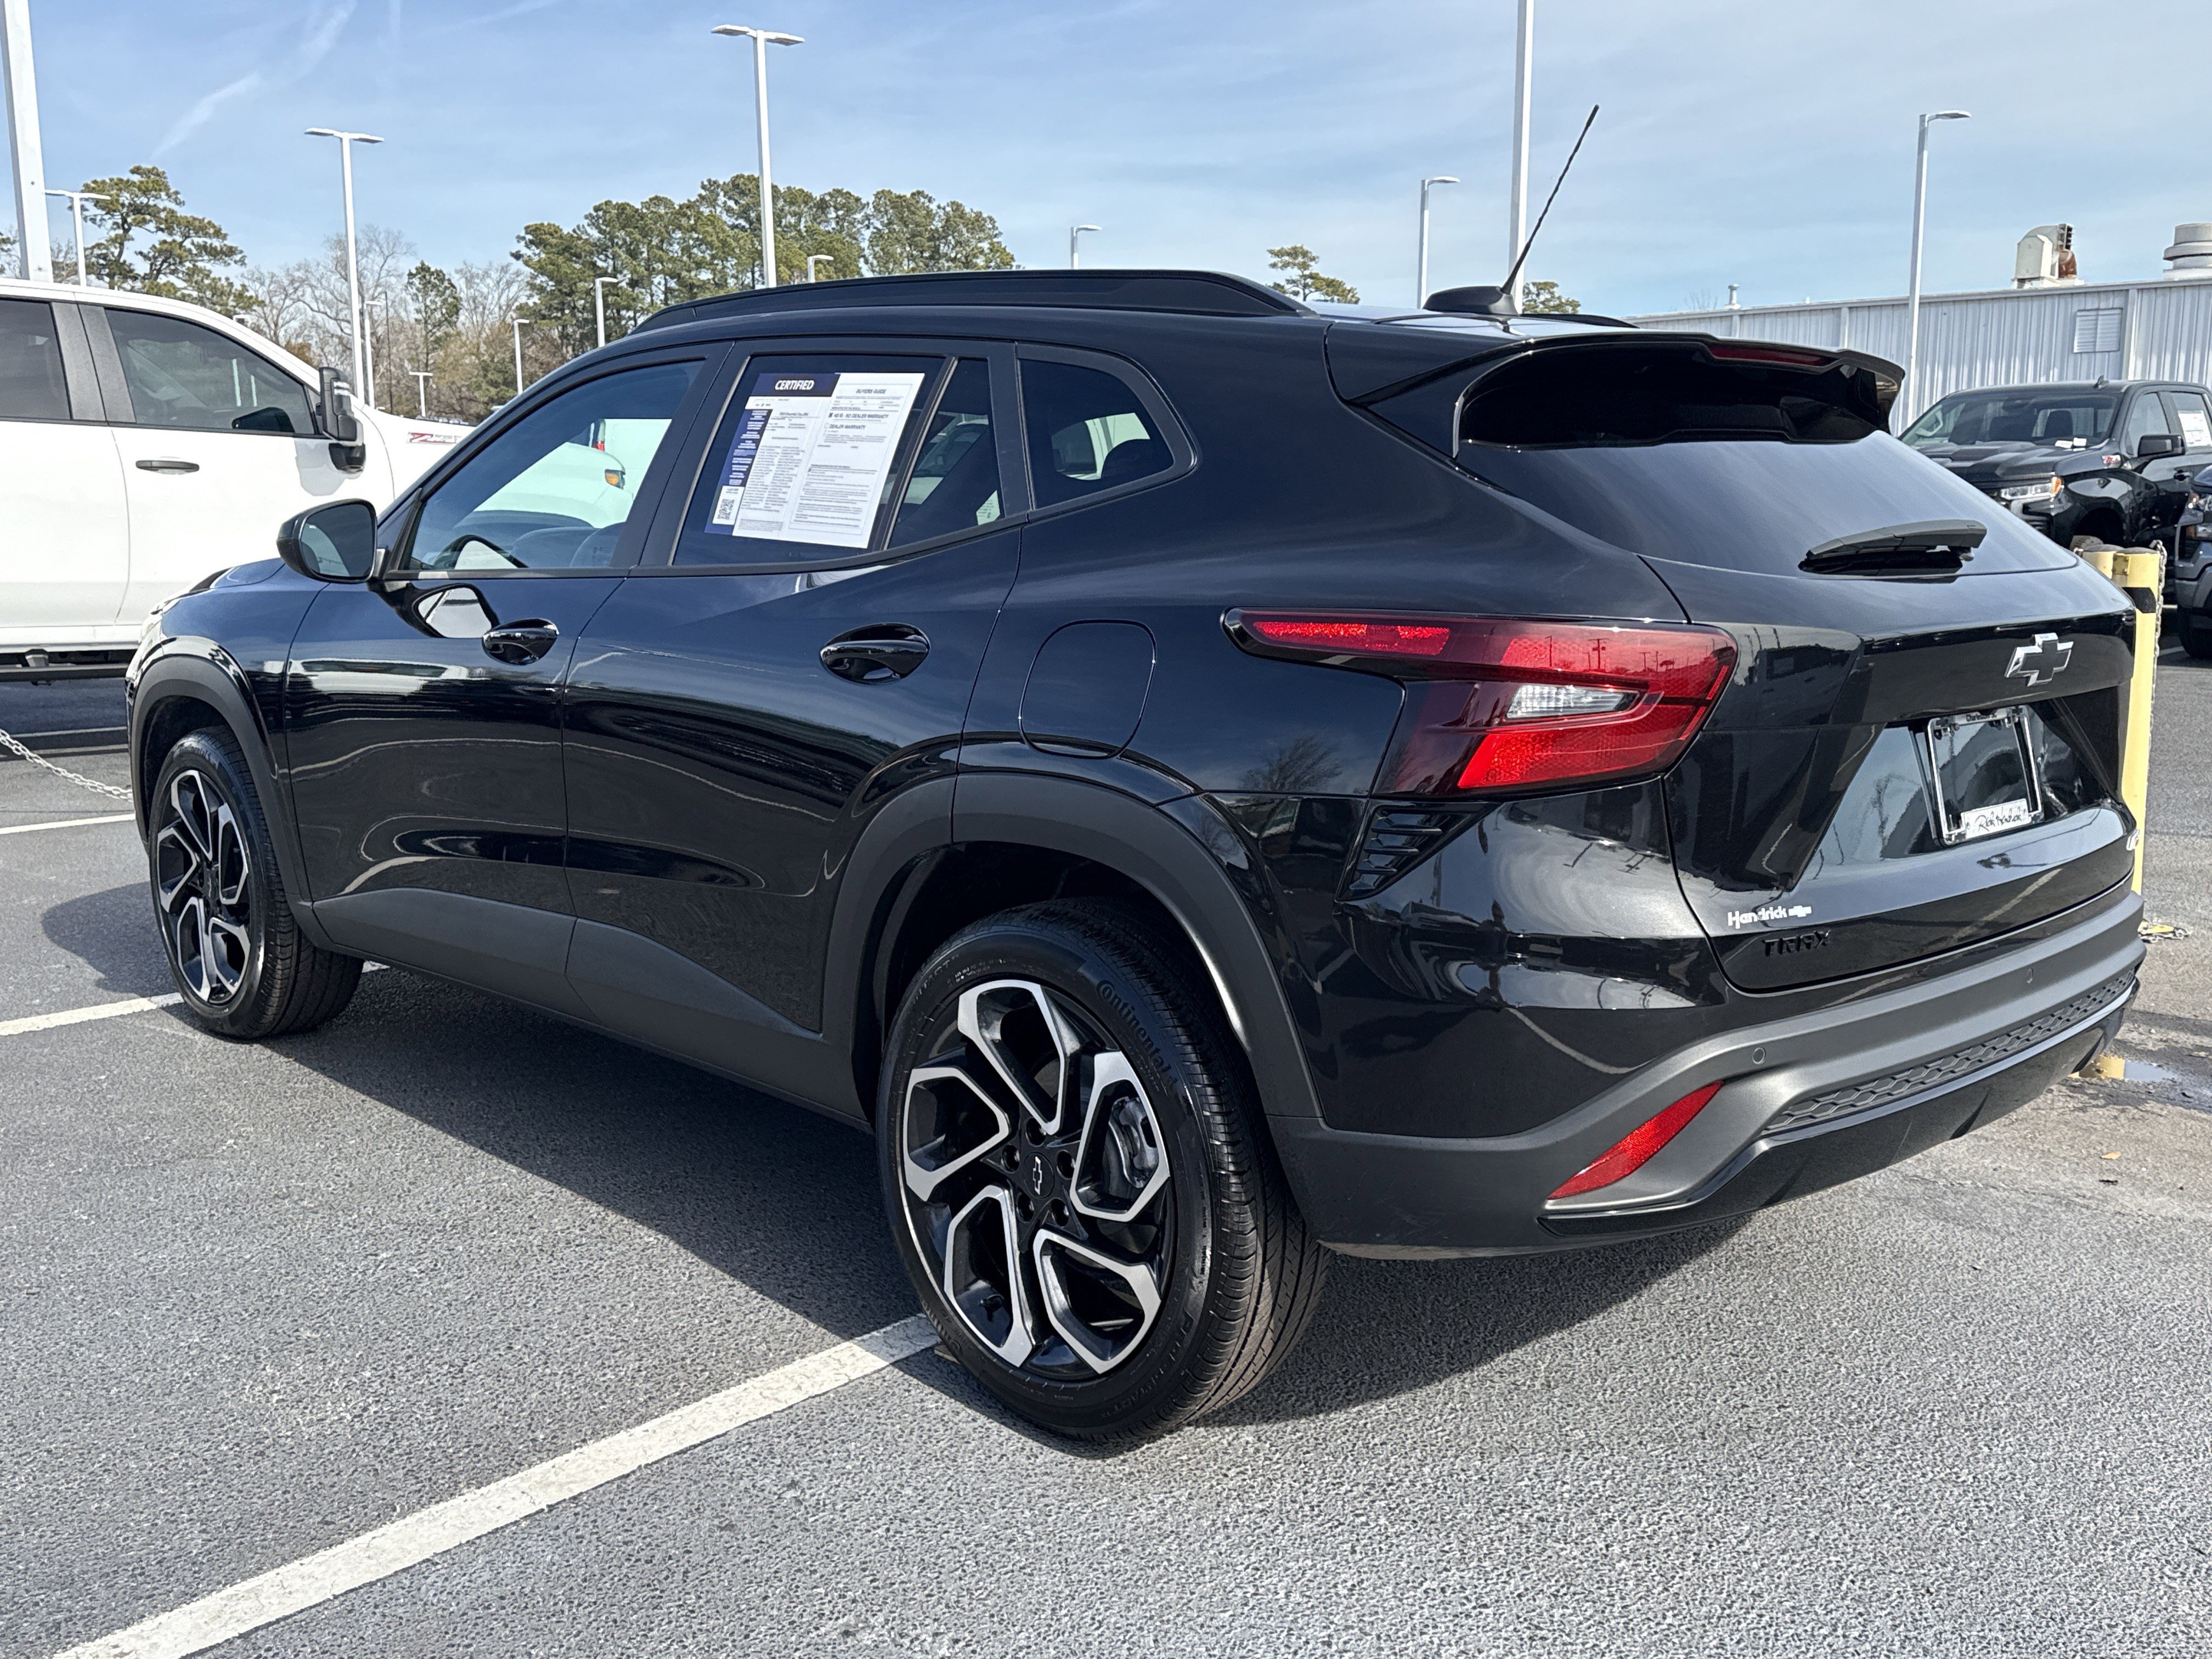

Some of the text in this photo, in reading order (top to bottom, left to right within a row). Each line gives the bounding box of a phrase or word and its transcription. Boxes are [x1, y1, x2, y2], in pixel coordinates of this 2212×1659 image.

[775, 380, 815, 390] CERTIFIED
[1728, 906, 1787, 929] Hendrick
[1761, 929, 1831, 957] TRAX
[1097, 979, 1172, 1075] Continental
